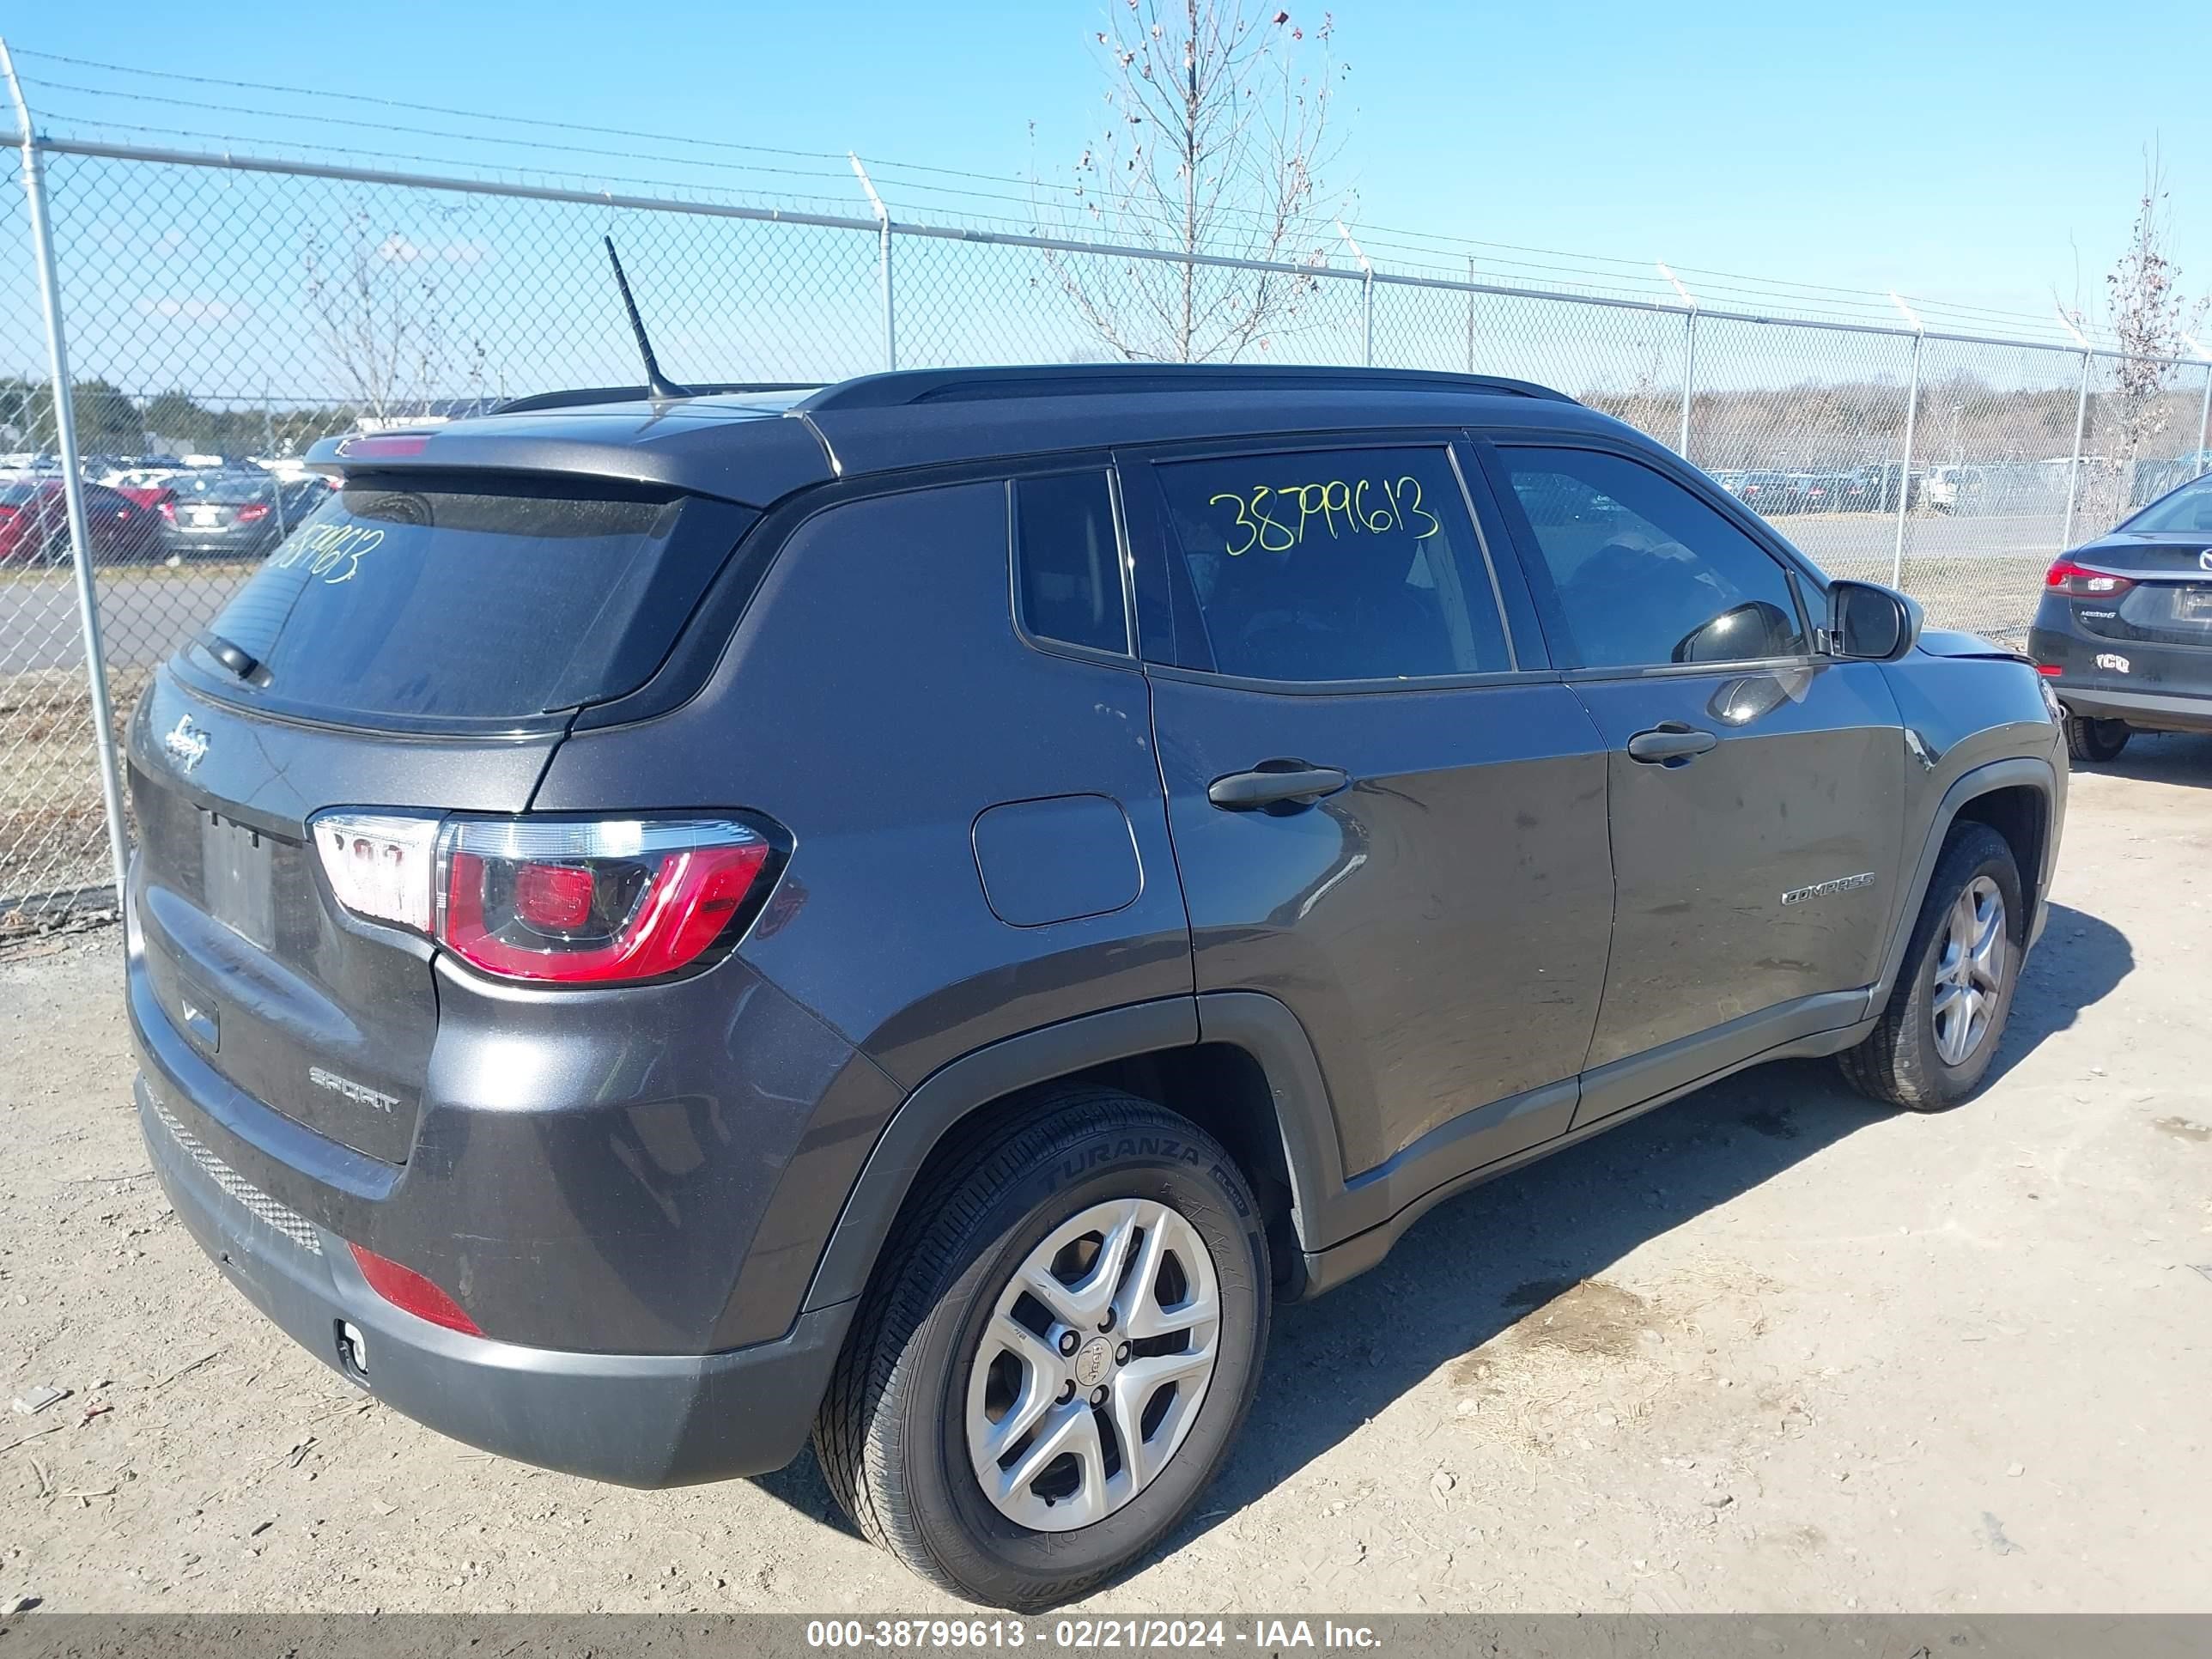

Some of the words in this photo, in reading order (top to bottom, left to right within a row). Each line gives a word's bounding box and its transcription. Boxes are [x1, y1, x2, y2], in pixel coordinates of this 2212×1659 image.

[1209, 477, 1439, 556] 38799613
[1781, 872, 1875, 906] COMPASS
[308, 1066, 401, 1114] SPORT
[1037, 1137, 1200, 1192] TURANZA
